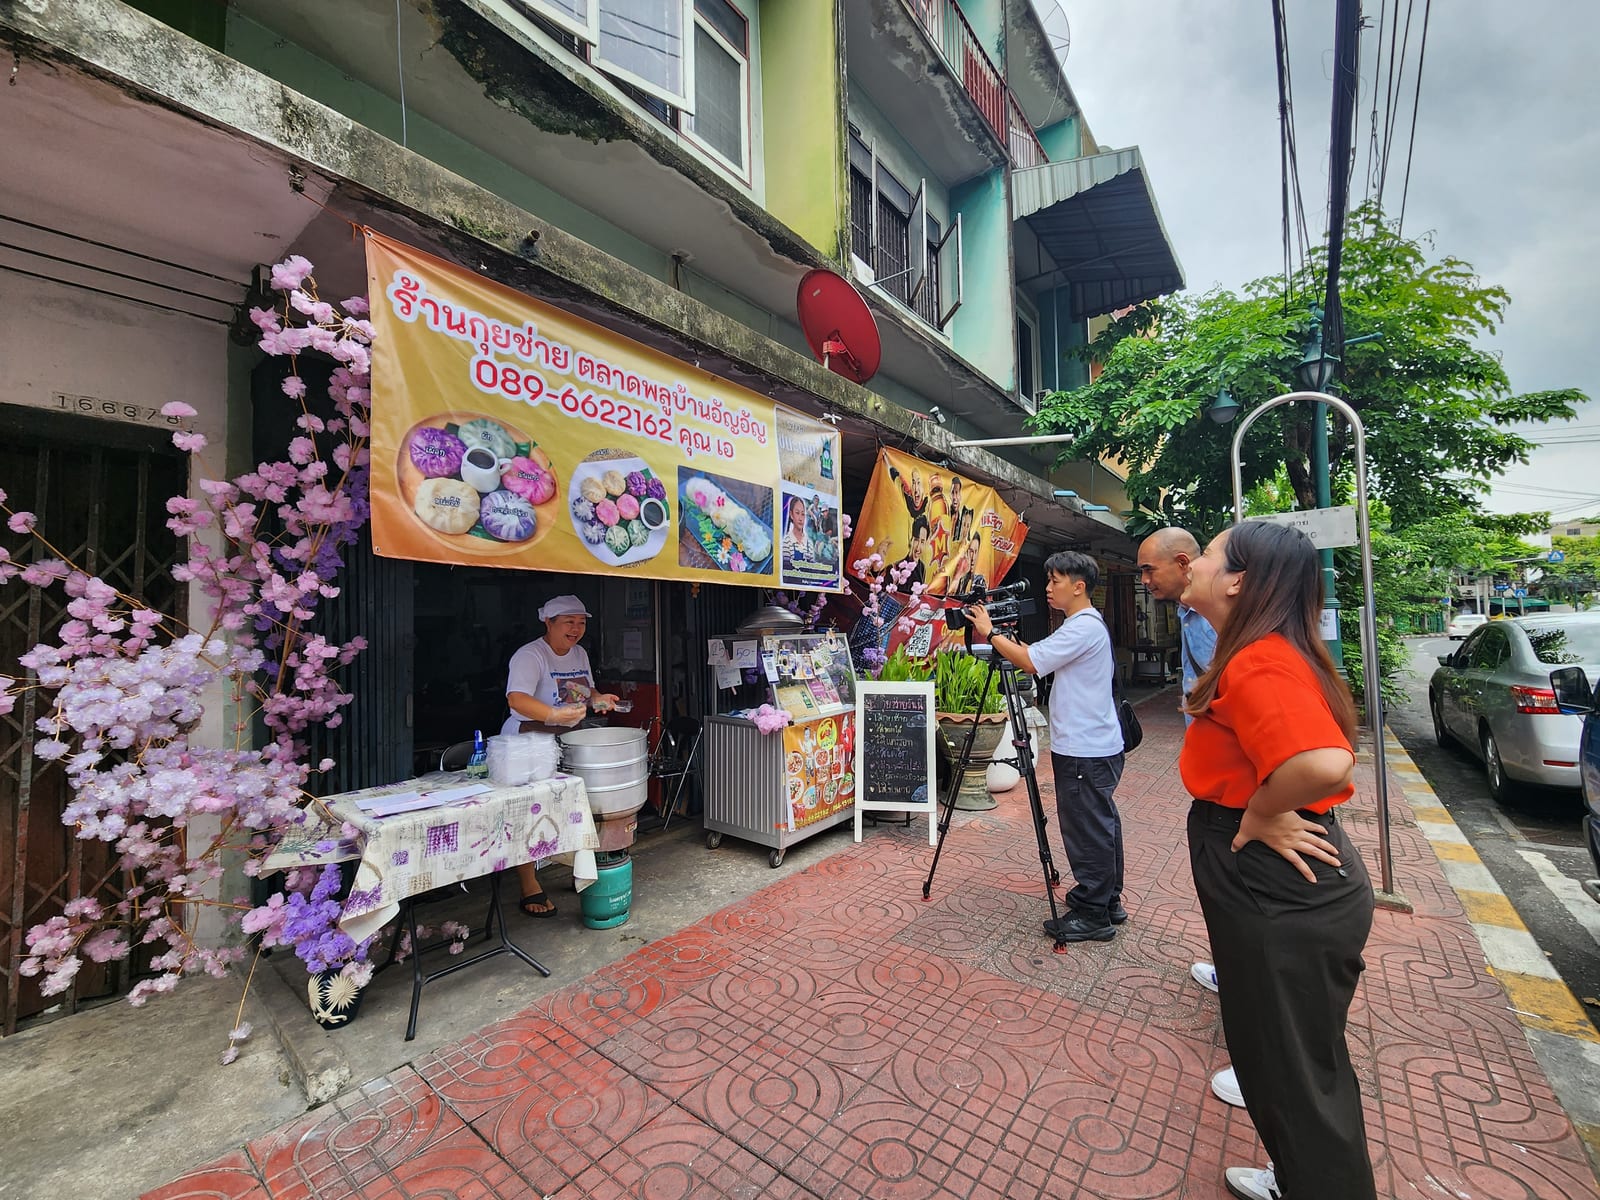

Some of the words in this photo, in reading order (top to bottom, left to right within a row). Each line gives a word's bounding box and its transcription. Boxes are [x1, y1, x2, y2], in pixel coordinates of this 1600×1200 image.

[393, 275, 569, 369] ร้านกุยช่าย
[578, 356, 766, 445] ตลาดพลูบ้านอัญอัญ
[475, 359, 673, 441] 089-6622162
[679, 428, 711, 456] คุณ
[717, 439, 734, 458] เอ
